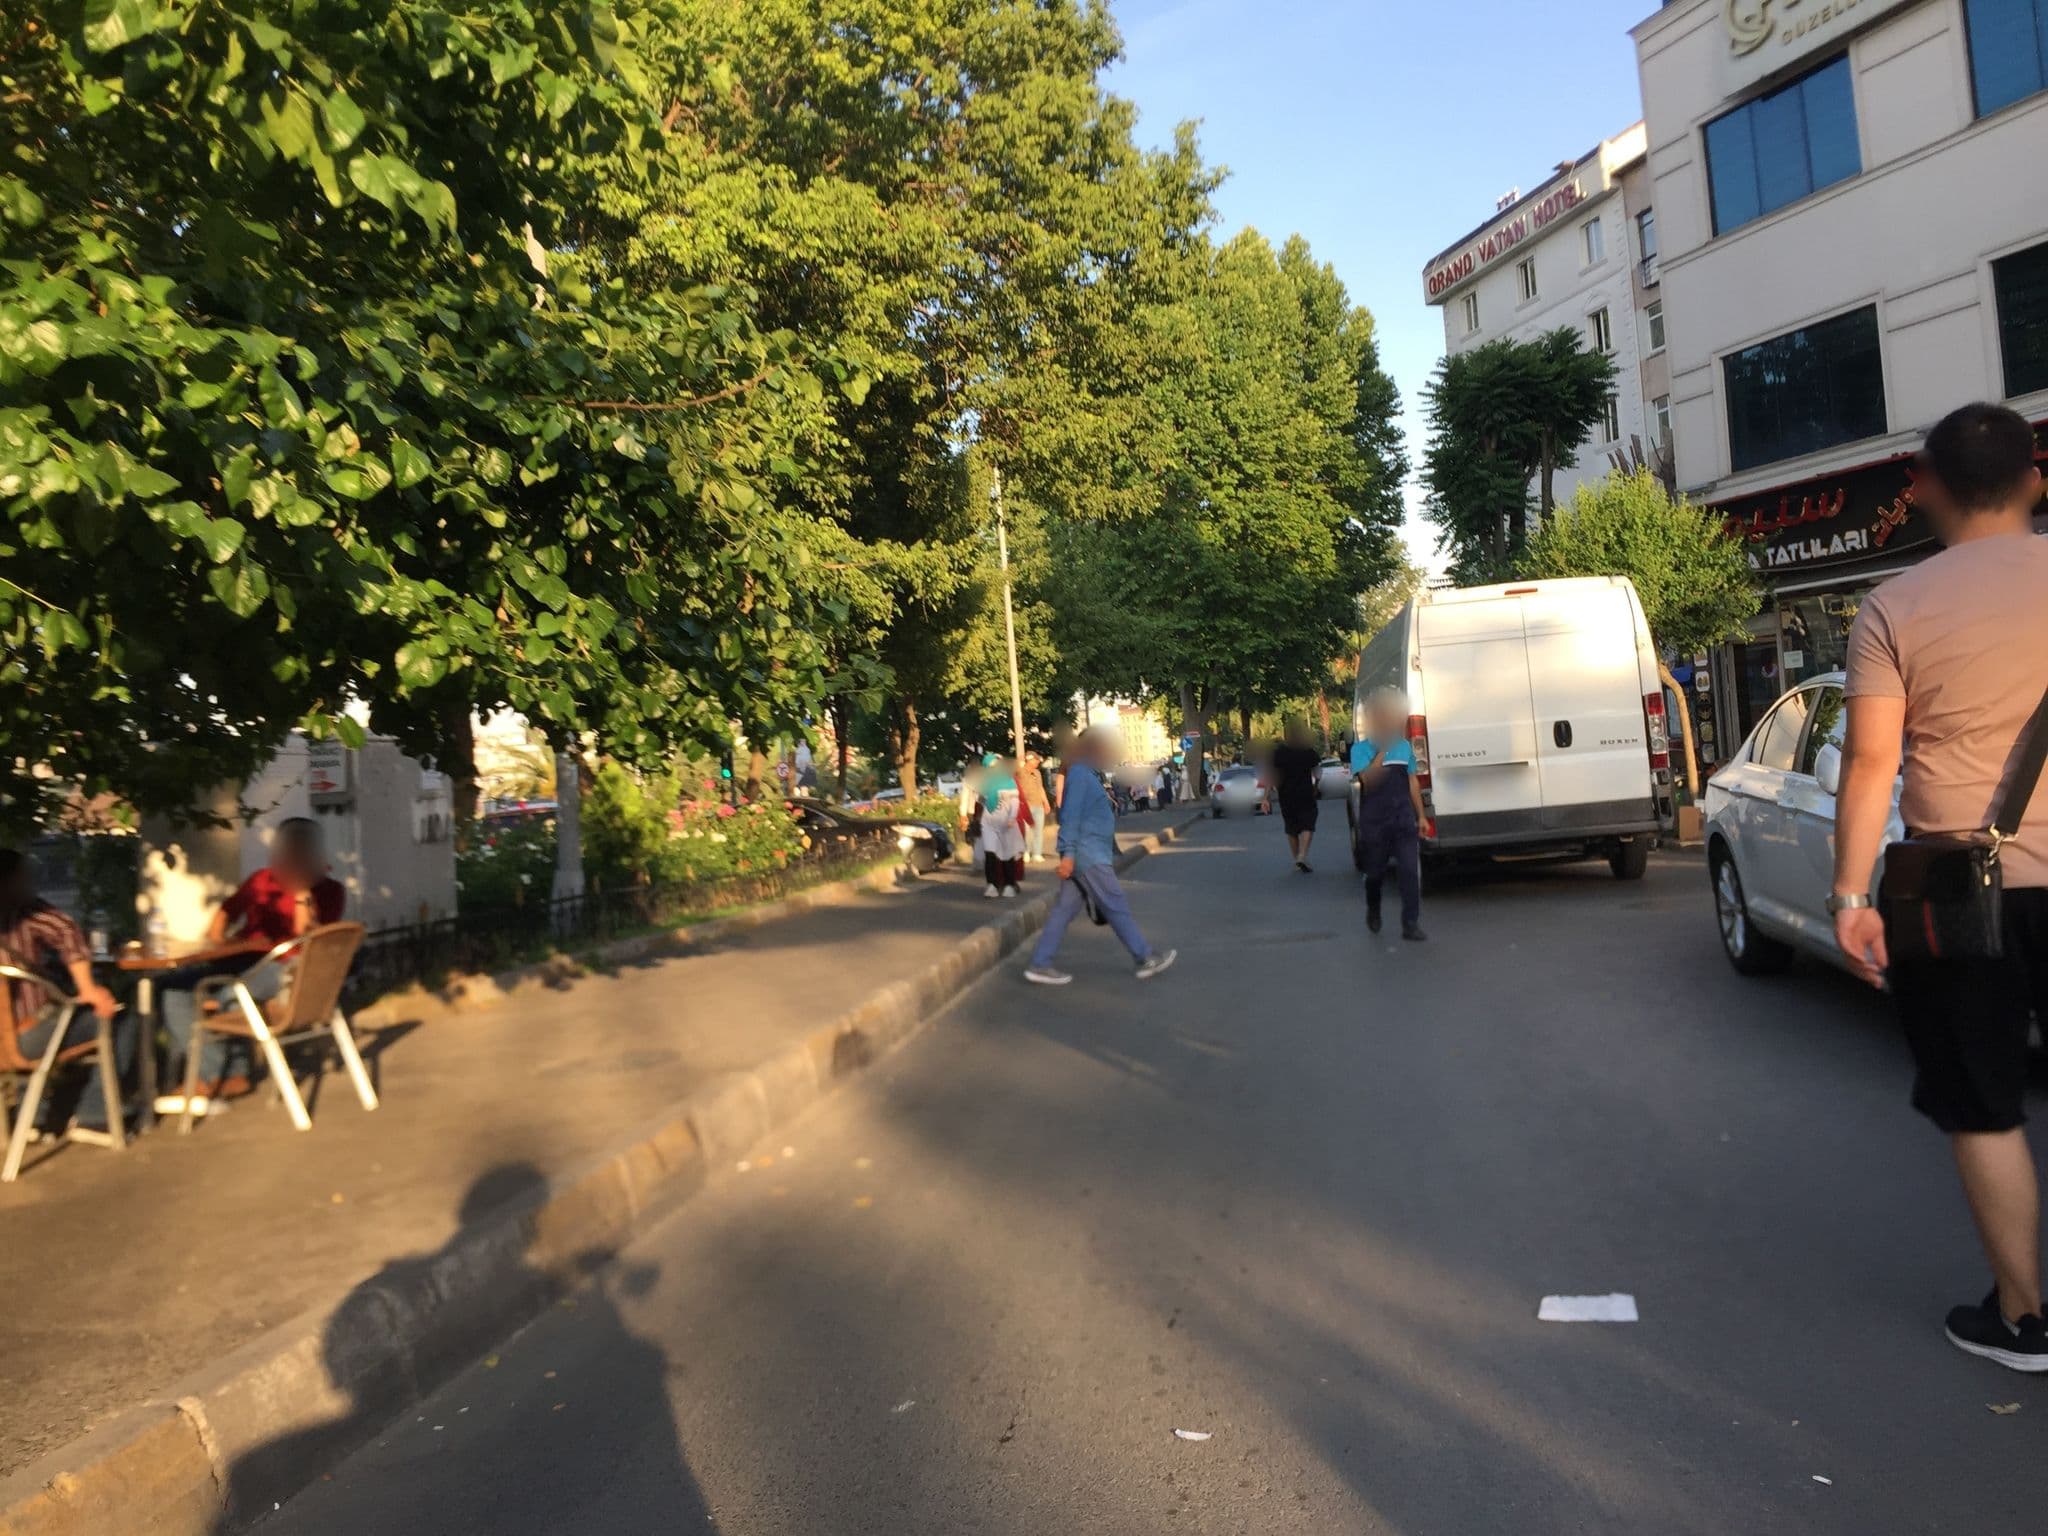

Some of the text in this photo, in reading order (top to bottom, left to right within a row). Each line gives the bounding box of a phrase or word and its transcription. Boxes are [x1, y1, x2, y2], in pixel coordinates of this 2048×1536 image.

[1478, 214, 1529, 262] VATAN
[1533, 178, 1588, 229] HOTEL
[1766, 528, 1869, 568] TATLILARI
[1436, 750, 1487, 760] PEUGEOT
